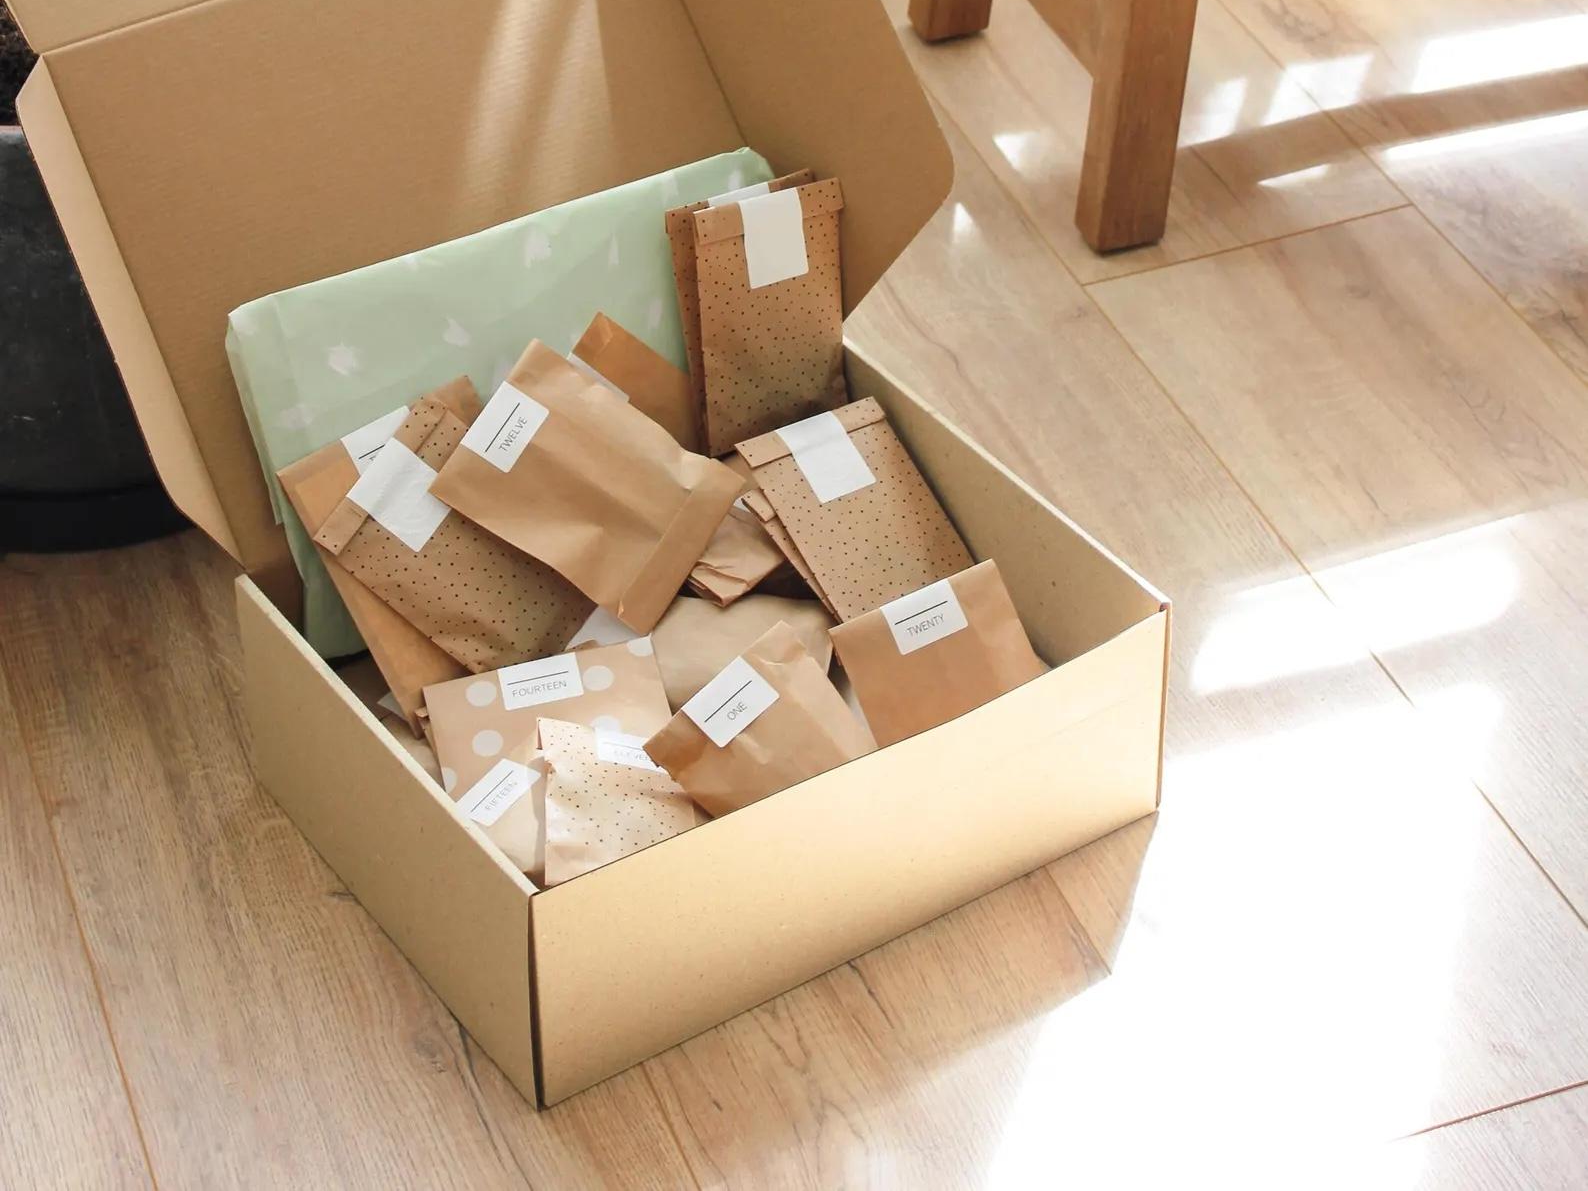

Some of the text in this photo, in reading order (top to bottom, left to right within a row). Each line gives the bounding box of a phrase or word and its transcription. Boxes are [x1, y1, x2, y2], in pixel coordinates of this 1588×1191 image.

[498, 416, 528, 452] TWELVE
[906, 613, 945, 637] TWENTY
[511, 680, 567, 698] FOURTEEN
[727, 701, 748, 720] ONE
